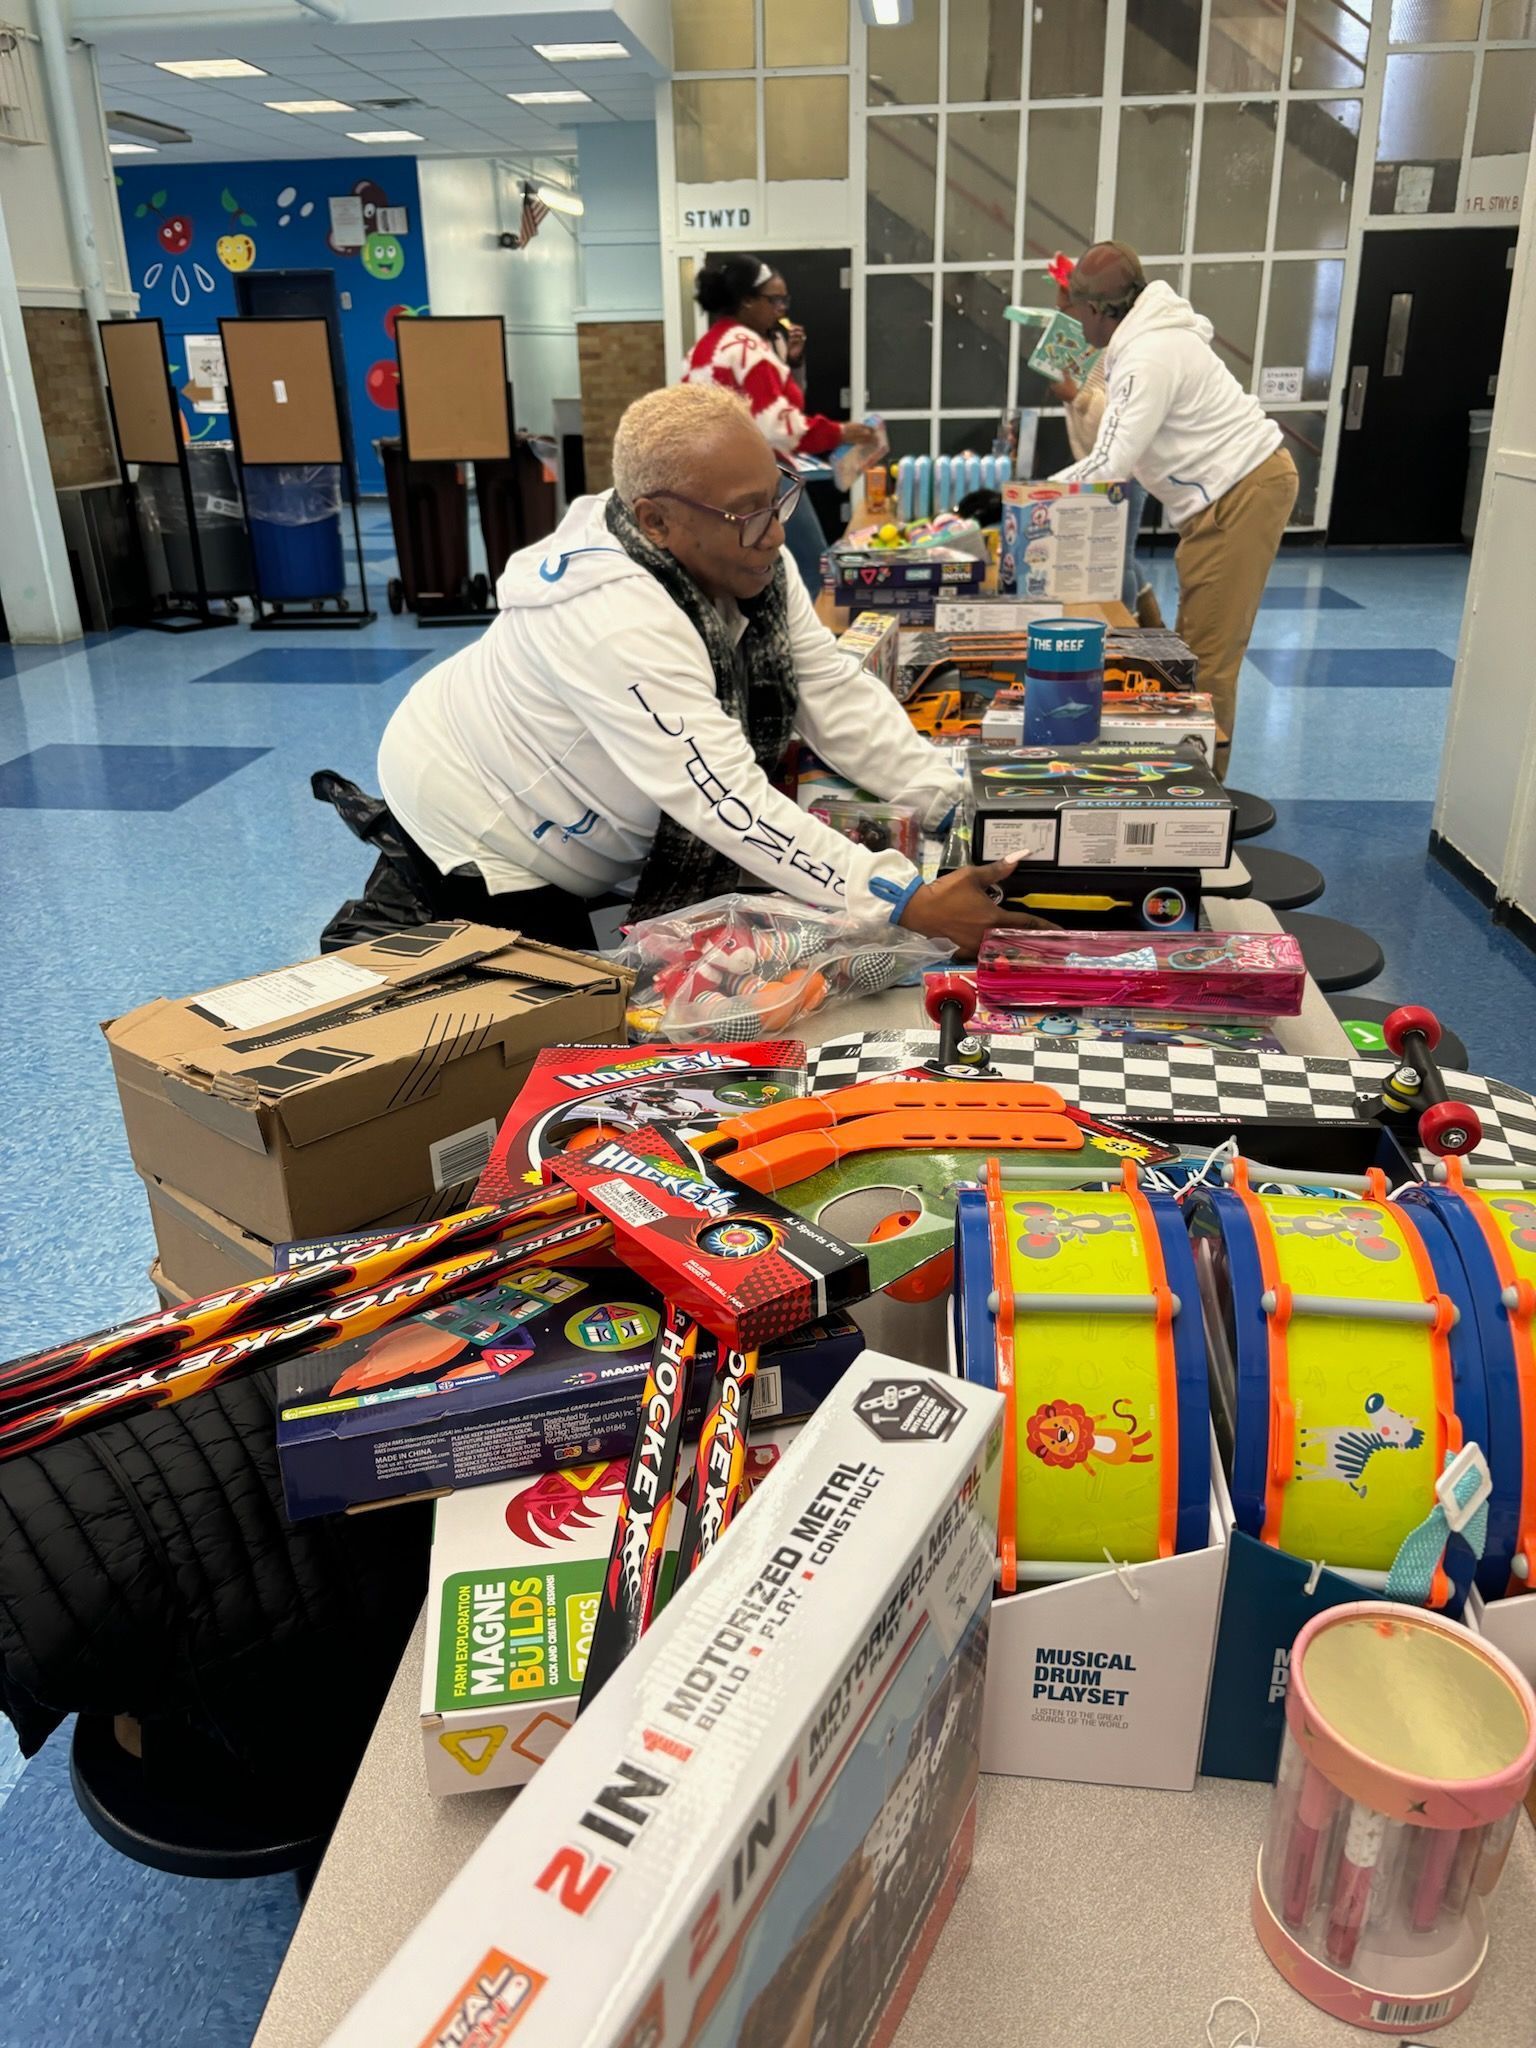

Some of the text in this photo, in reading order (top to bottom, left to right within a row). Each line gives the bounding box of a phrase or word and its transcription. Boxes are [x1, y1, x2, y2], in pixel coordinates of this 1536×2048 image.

[1474, 197, 1485, 211] FL
[1033, 638, 1053, 651] THE
[1056, 639, 1085, 652] REEF
[249, 1028, 315, 1051] WARNING:
[557, 1050, 717, 1090] HOCKEY
[587, 1143, 740, 1207] HOCKEY
[626, 1189, 664, 1219] WARNING:
[288, 1231, 401, 1253] COSMIC EXPLORATI
[783, 1217, 846, 1257] AJ Sports Fun
[60, 1219, 602, 1415] HOCKEY UPERSTAR
[543, 1412, 577, 1427] Distributed
[544, 1421, 560, 1432] RMS
[562, 1414, 601, 1429] International
[602, 1410, 622, 1421] (USA)
[623, 1408, 635, 1418] Inc.
[909, 1398, 937, 1433] WITH OTHER
[391, 1438, 403, 1446] RMS
[403, 1431, 438, 1444] International
[451, 1421, 532, 1442] PLEASE KEEP THIS INFORMATION
[452, 1435, 482, 1447] FOR FUTURE
[544, 1423, 590, 1439] 39 High Street
[544, 1434, 562, 1445] North
[594, 1426, 605, 1436] MA
[606, 1422, 626, 1434] 01845
[374, 1447, 386, 1455] RMS
[386, 1441, 421, 1453] International
[422, 1438, 436, 1447] (USA)
[452, 1433, 526, 1453] CONTENTS AND RESULTS MAY
[453, 1439, 526, 1458] NOT SUITABLE FOR CHILDREN
[453, 1454, 472, 1464] UNDER
[477, 1450, 492, 1459] YEARS
[501, 1447, 510, 1455] AGE
[512, 1445, 522, 1453] DUE
[531, 1441, 540, 1449] THE
[621, 1327, 685, 1576] HOCKEY
[701, 1352, 747, 1555] OCKEY
[375, 1446, 432, 1464] MADE IN CHINA
[376, 1462, 388, 1470] Visit
[454, 1447, 540, 1469] PRESENCE SMALL PARTS WHICH
[454, 1466, 466, 1474] MAY
[467, 1462, 488, 1472] PRESENT
[494, 1456, 518, 1467] CHOKING
[376, 1465, 404, 1475] Questions
[455, 1464, 506, 1479] ADULT SUPERVISION
[662, 1461, 867, 1722] MOTORIZED METAL
[694, 1466, 885, 1732] BUILD PLAY CONSTRUCT
[579, 1599, 599, 1634] PCS
[809, 1561, 923, 1752] MOTORIZED
[928, 1463, 981, 1556] METAL
[470, 1582, 506, 1695] MAGNE
[546, 1575, 559, 1685] CLICK AND CREATE 3D DESIGNS!
[808, 1703, 850, 1777] BUILD
[869, 1619, 902, 1676] PLAY
[917, 1481, 981, 1597] CONSTRUCT
[454, 1585, 472, 1697] FARM EXPLORATION
[1036, 1648, 1136, 1671] MUSICAL
[1034, 1666, 1102, 1686] DRUM
[1033, 1683, 1129, 1706] PLAYSET
[1032, 1714, 1129, 1729] SOUNDS OF THE WORLD
[1035, 1707, 1124, 1721] LISTEN TO THE GREAT
[534, 1728, 694, 1917] 2 IN 1
[732, 1796, 779, 1904] IN
[788, 1754, 800, 1811] 1
